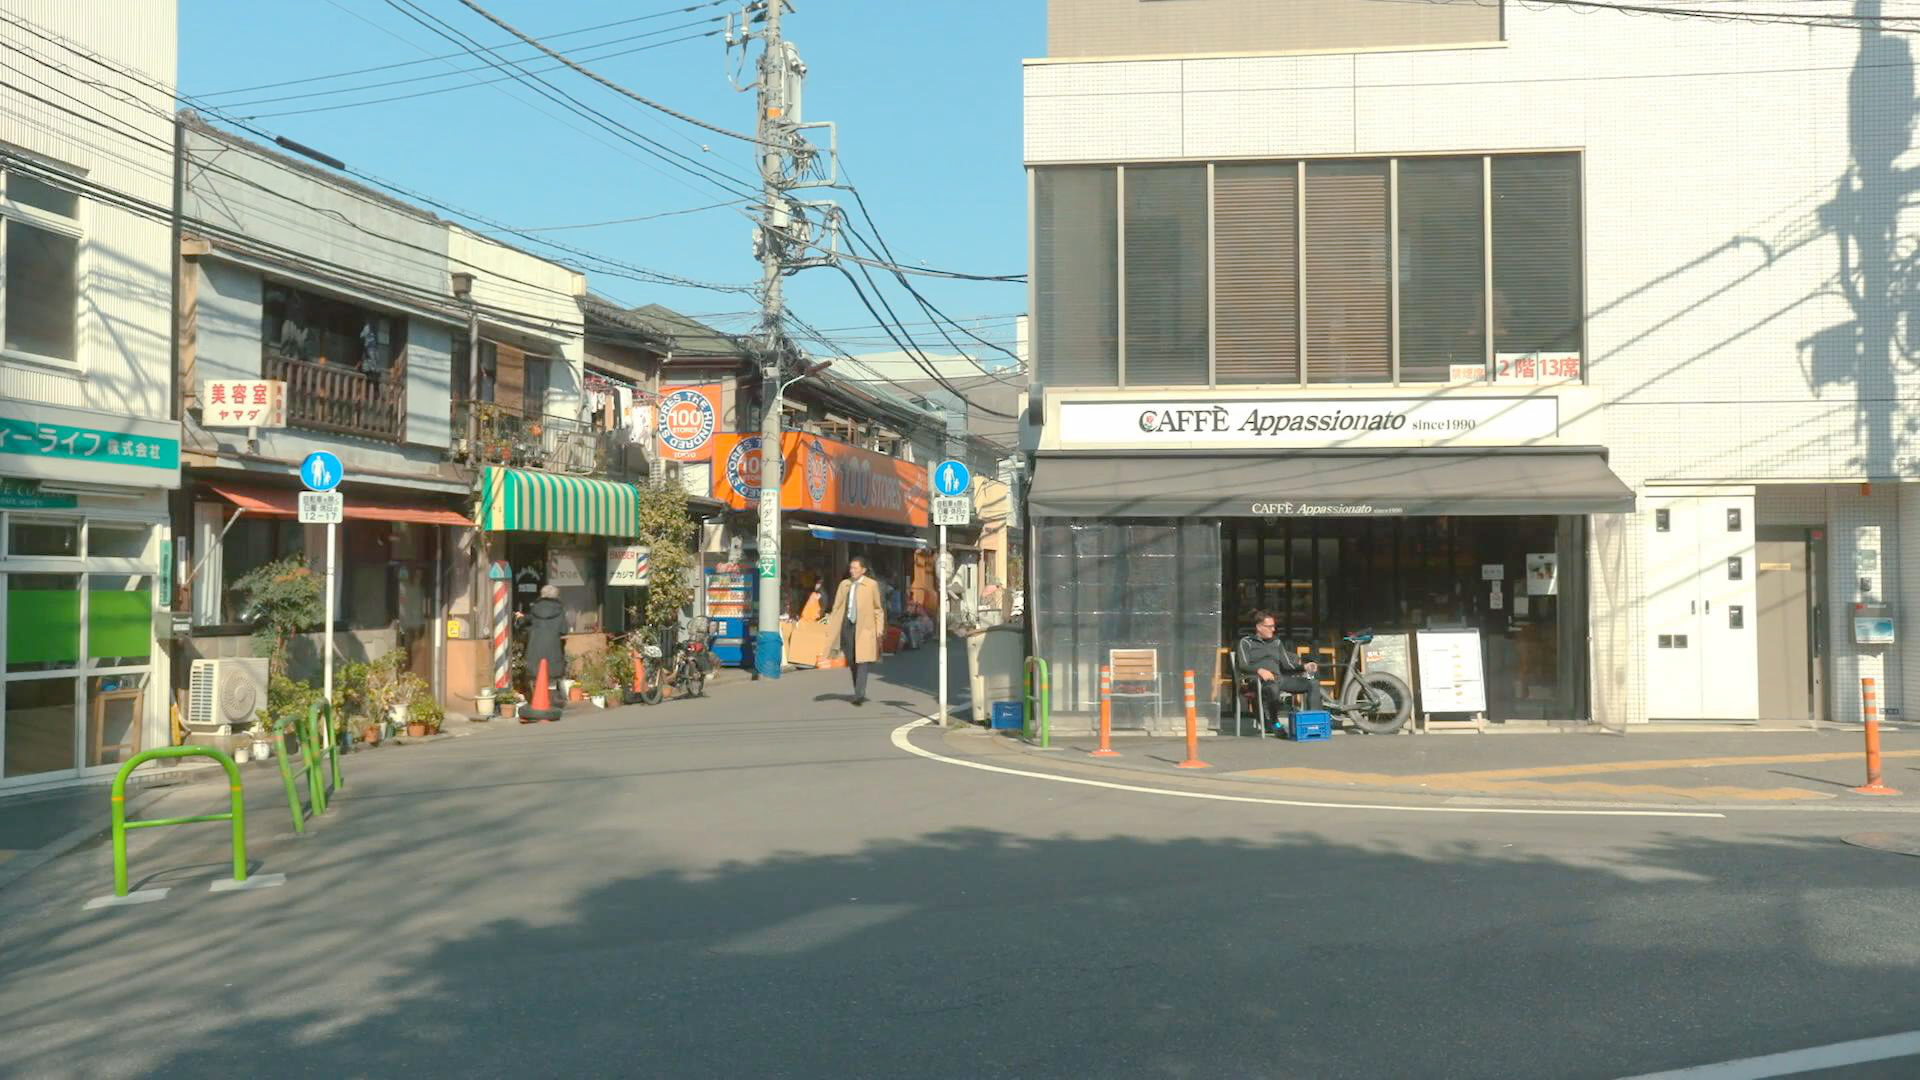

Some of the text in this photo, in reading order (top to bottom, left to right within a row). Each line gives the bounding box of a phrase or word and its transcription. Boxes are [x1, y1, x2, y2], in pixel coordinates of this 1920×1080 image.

[1539, 358, 1580, 377] 13席
[211, 384, 267, 404] 美容室
[218, 409, 261, 421] ヤマダ
[670, 409, 702, 426] 100
[1139, 405, 1476, 436] CAFFÈ Appassionato since1990
[107, 439, 161, 460] 株式会社
[1252, 502, 1294, 514] CAFFÈ
[1297, 503, 1372, 516] Appassionato
